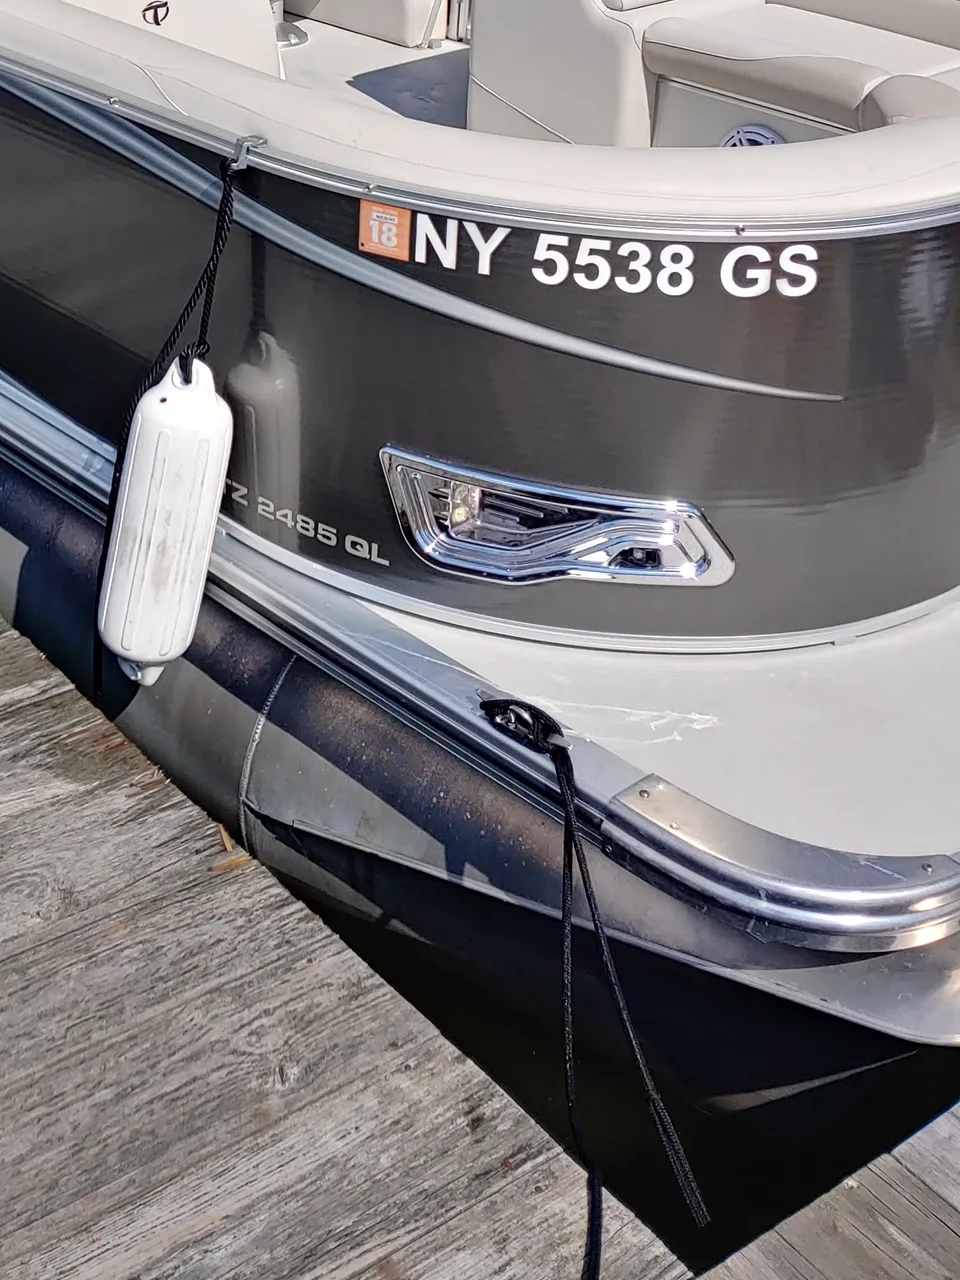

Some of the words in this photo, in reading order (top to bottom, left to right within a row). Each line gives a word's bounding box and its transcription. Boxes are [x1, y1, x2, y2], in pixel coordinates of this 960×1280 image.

[369, 220, 398, 248] 18
[414, 212, 512, 276] NY
[531, 232, 695, 297] 5538
[720, 244, 818, 298] GS
[257, 496, 338, 547] 2485
[344, 534, 390, 567] QL
